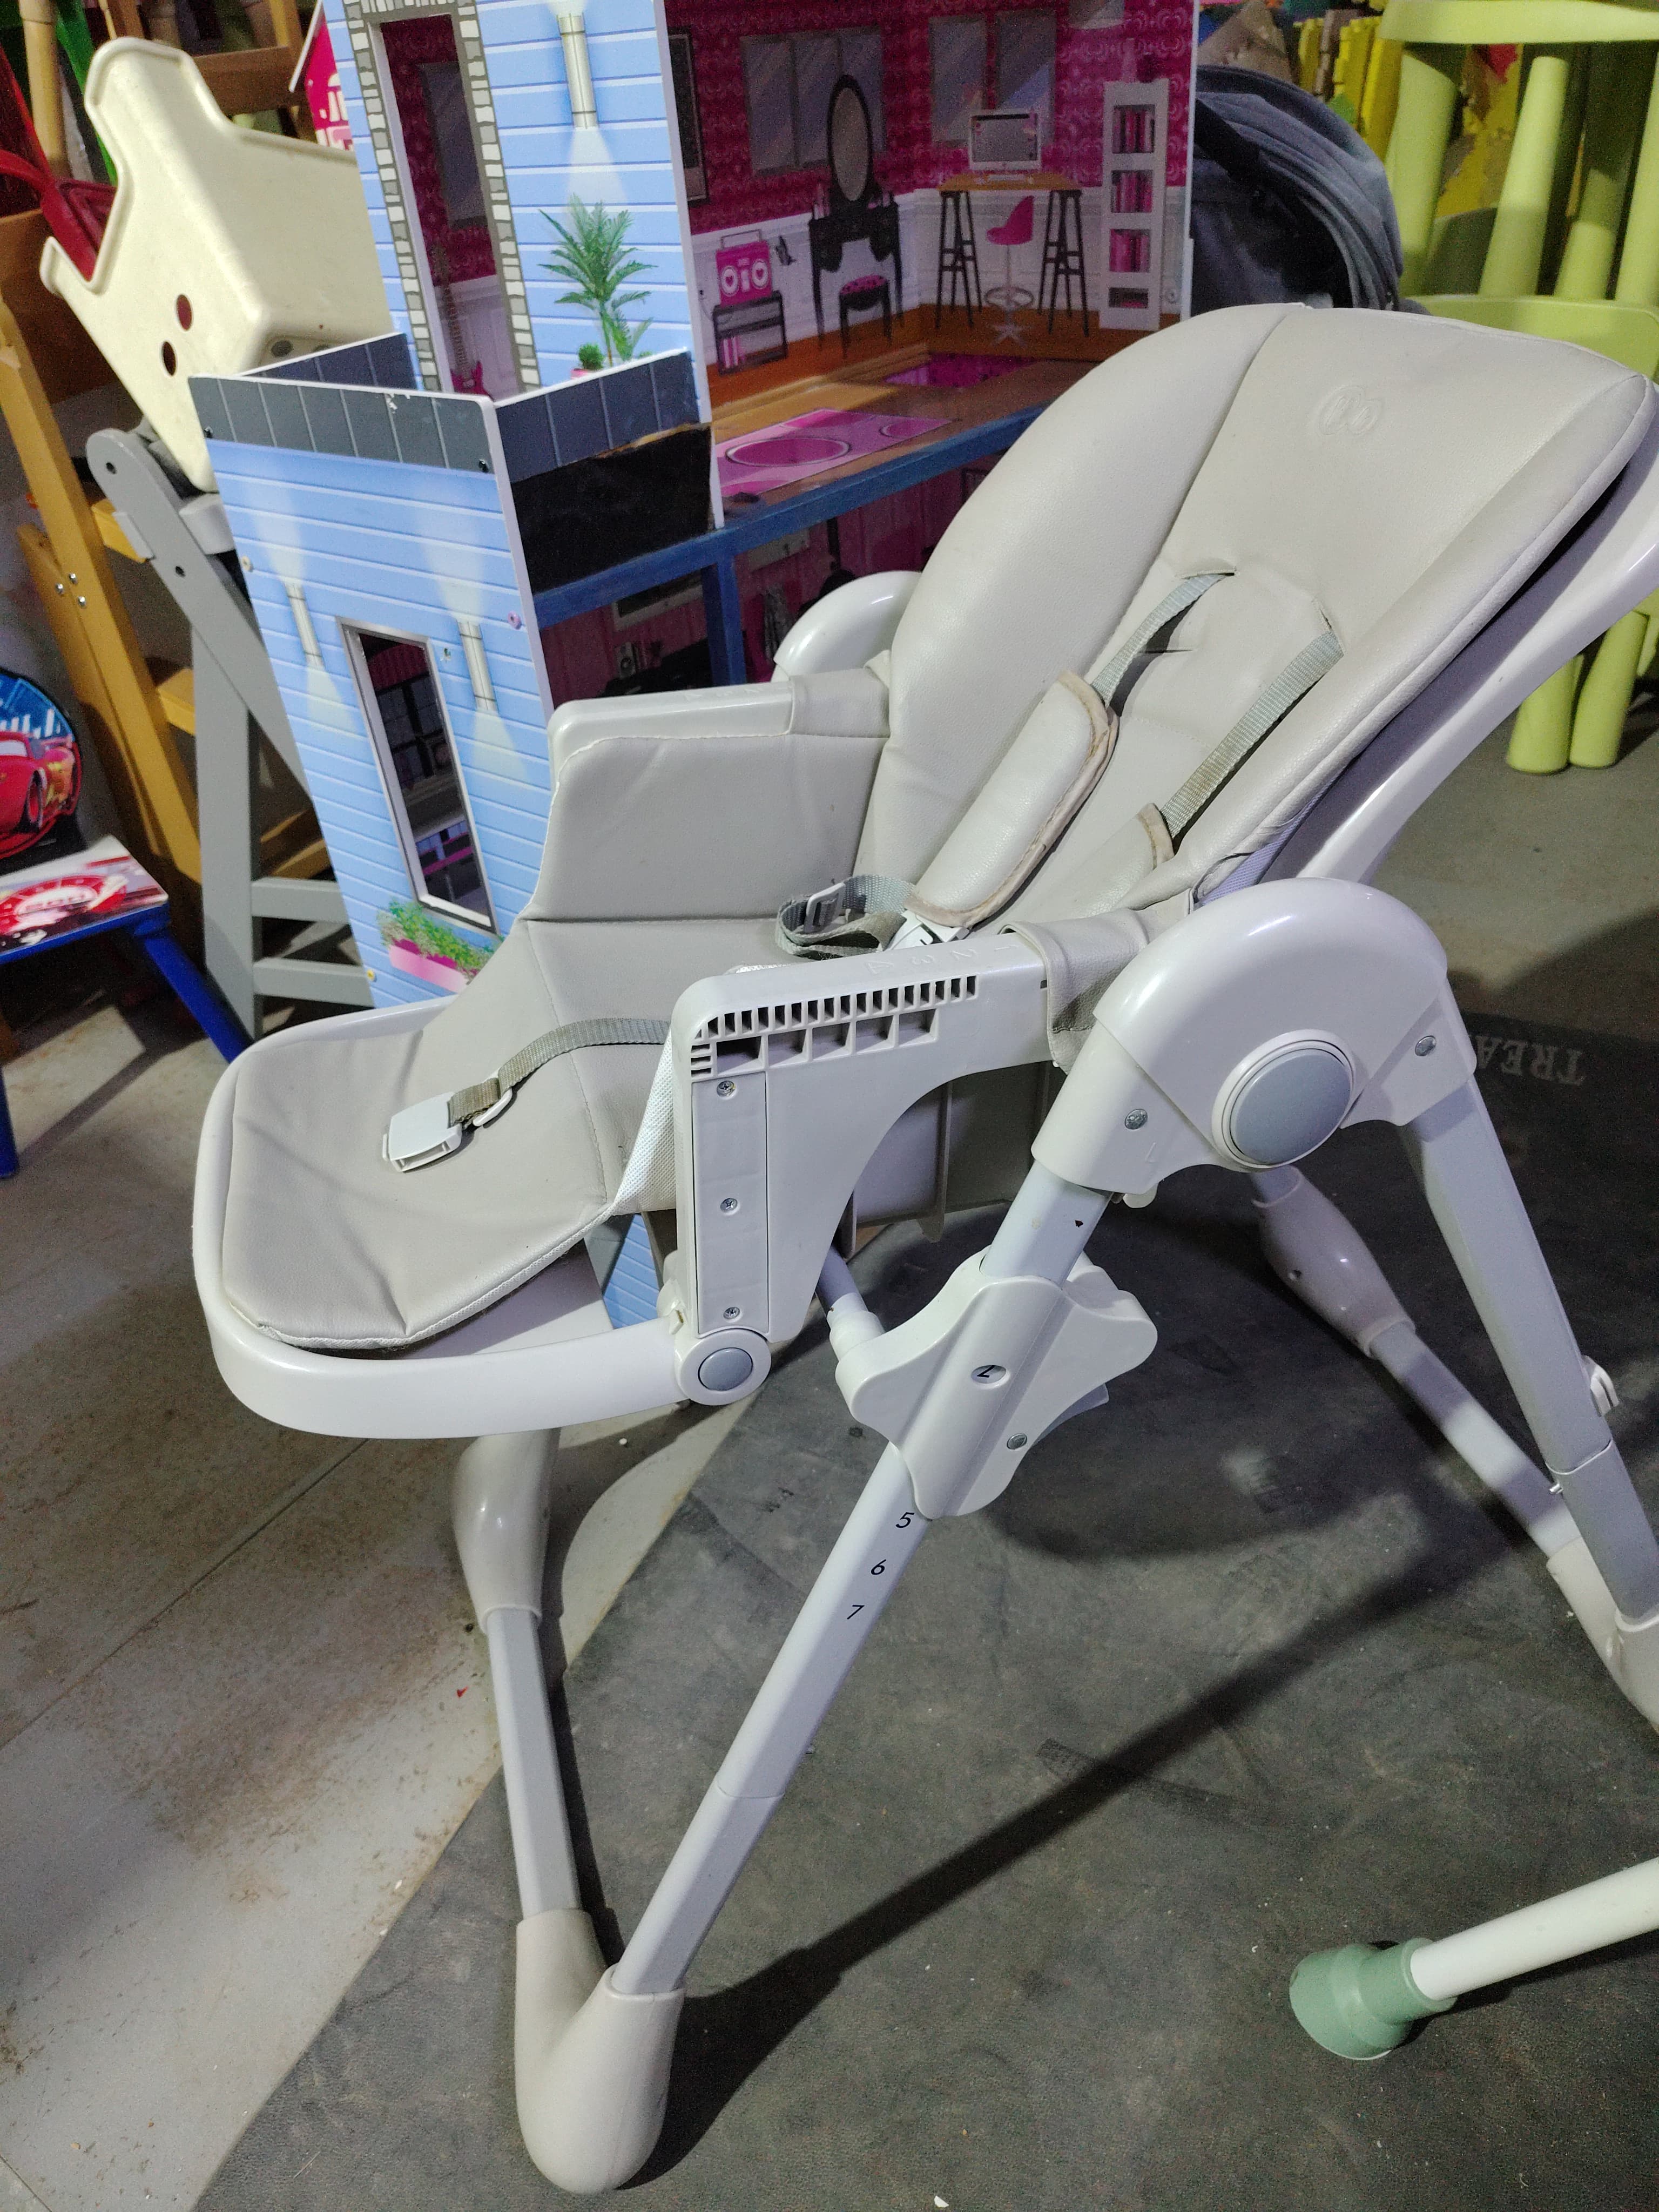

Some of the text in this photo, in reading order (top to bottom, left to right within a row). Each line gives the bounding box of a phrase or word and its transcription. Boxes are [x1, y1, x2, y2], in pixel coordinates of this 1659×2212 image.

[895, 1512, 915, 1528] 5
[871, 1559, 887, 1575] 6
[846, 1604, 865, 1620] 7
